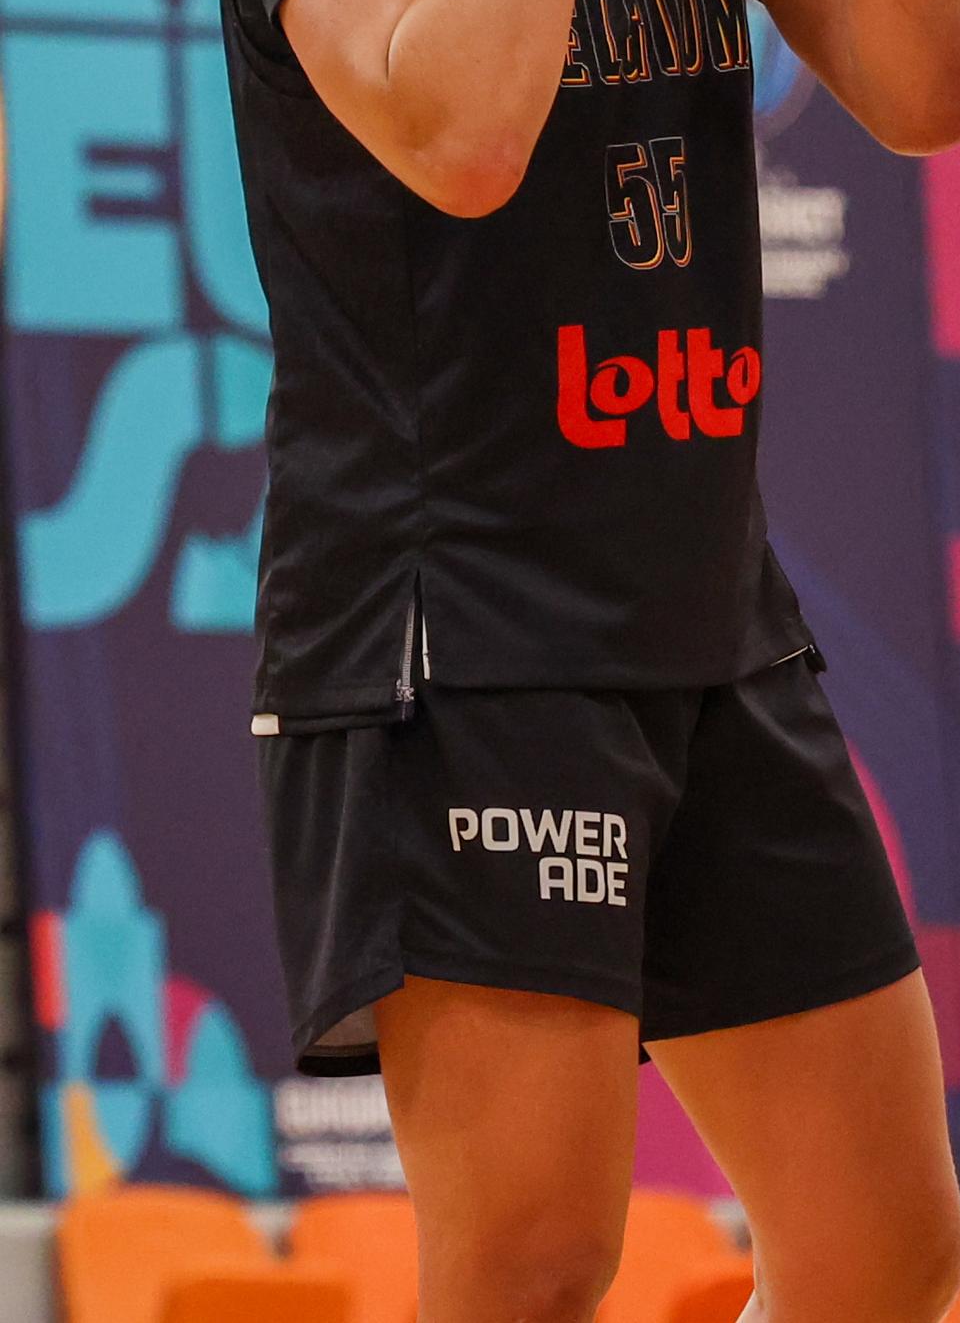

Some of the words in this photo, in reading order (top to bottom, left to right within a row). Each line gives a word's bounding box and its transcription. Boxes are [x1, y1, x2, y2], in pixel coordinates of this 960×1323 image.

[604, 136, 693, 270] 55
[448, 807, 628, 859] POWER
[538, 856, 629, 907] ADE
